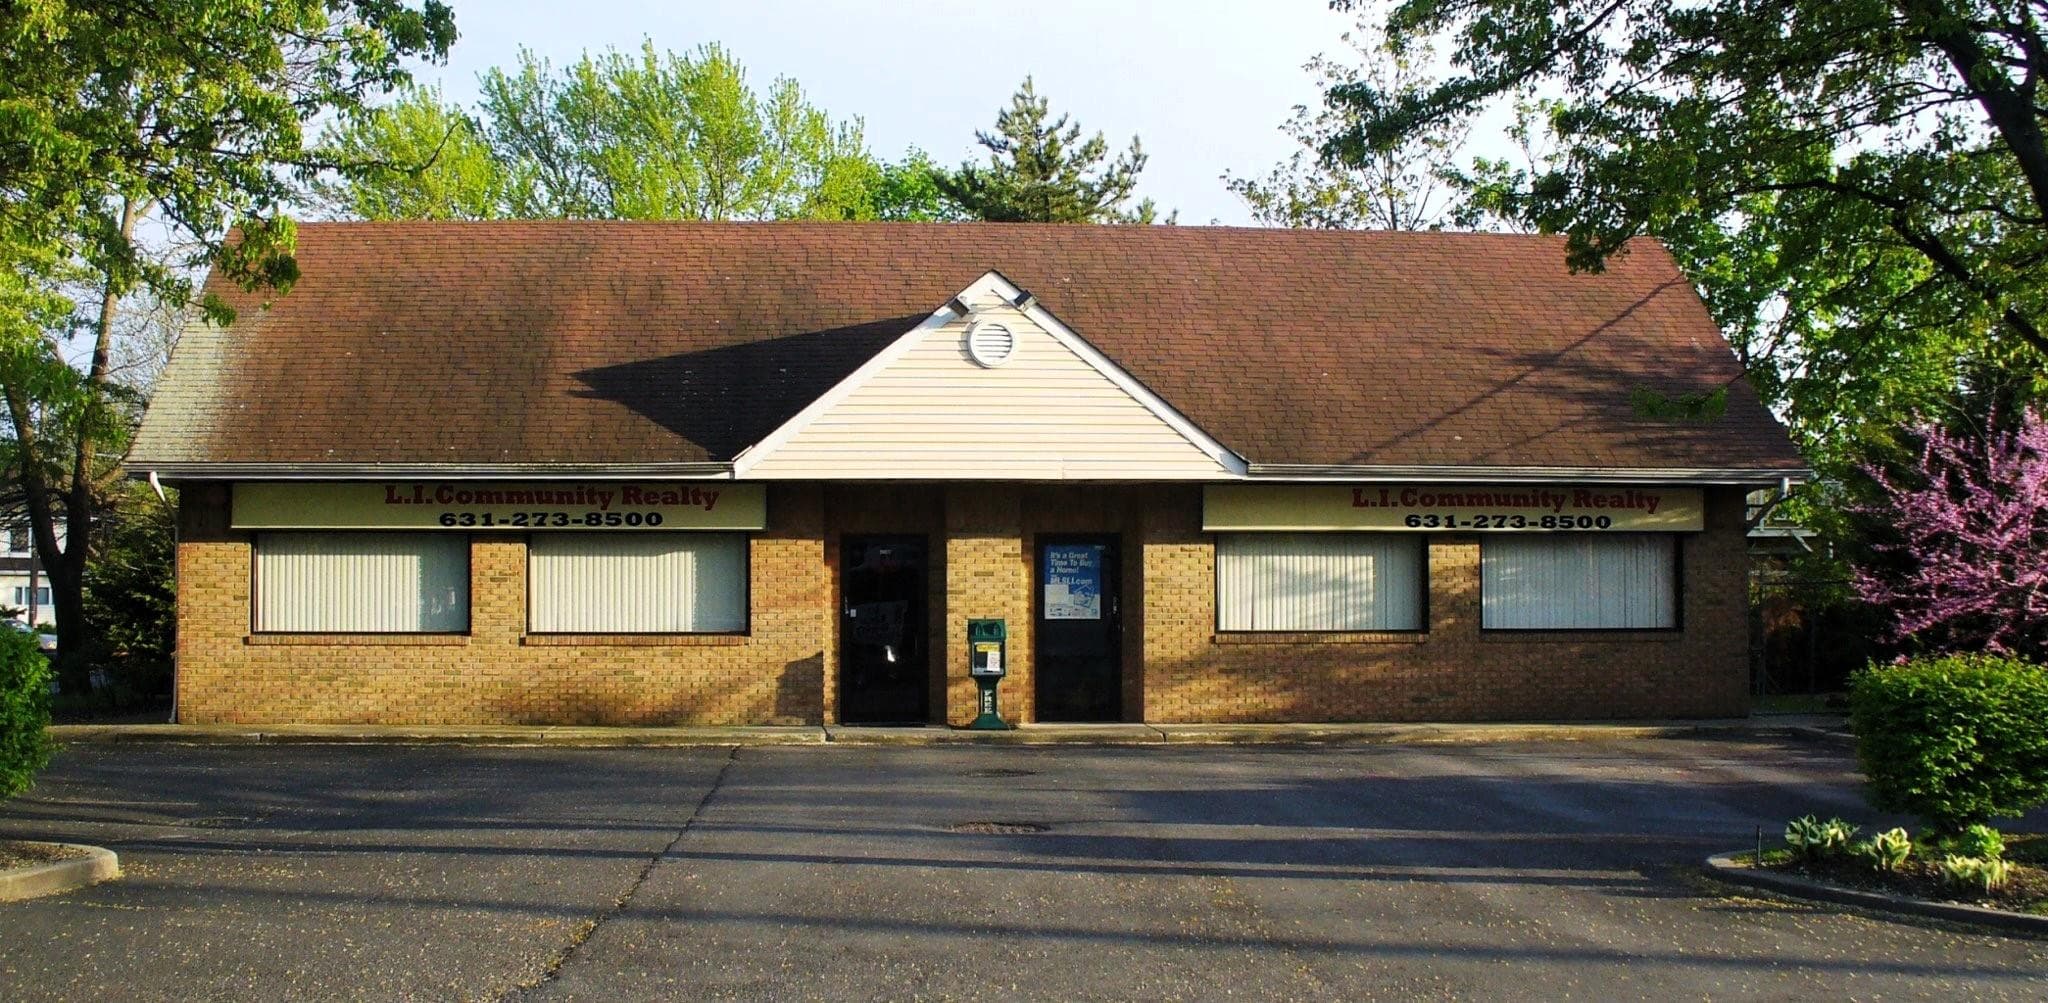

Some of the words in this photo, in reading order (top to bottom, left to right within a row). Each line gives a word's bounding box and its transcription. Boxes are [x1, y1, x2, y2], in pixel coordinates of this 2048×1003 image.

[621, 486, 719, 511] Realty
[1572, 489, 1661, 514] Realty
[439, 512, 663, 527] 631-273-8500
[1405, 514, 1611, 529] 631-273-8500
